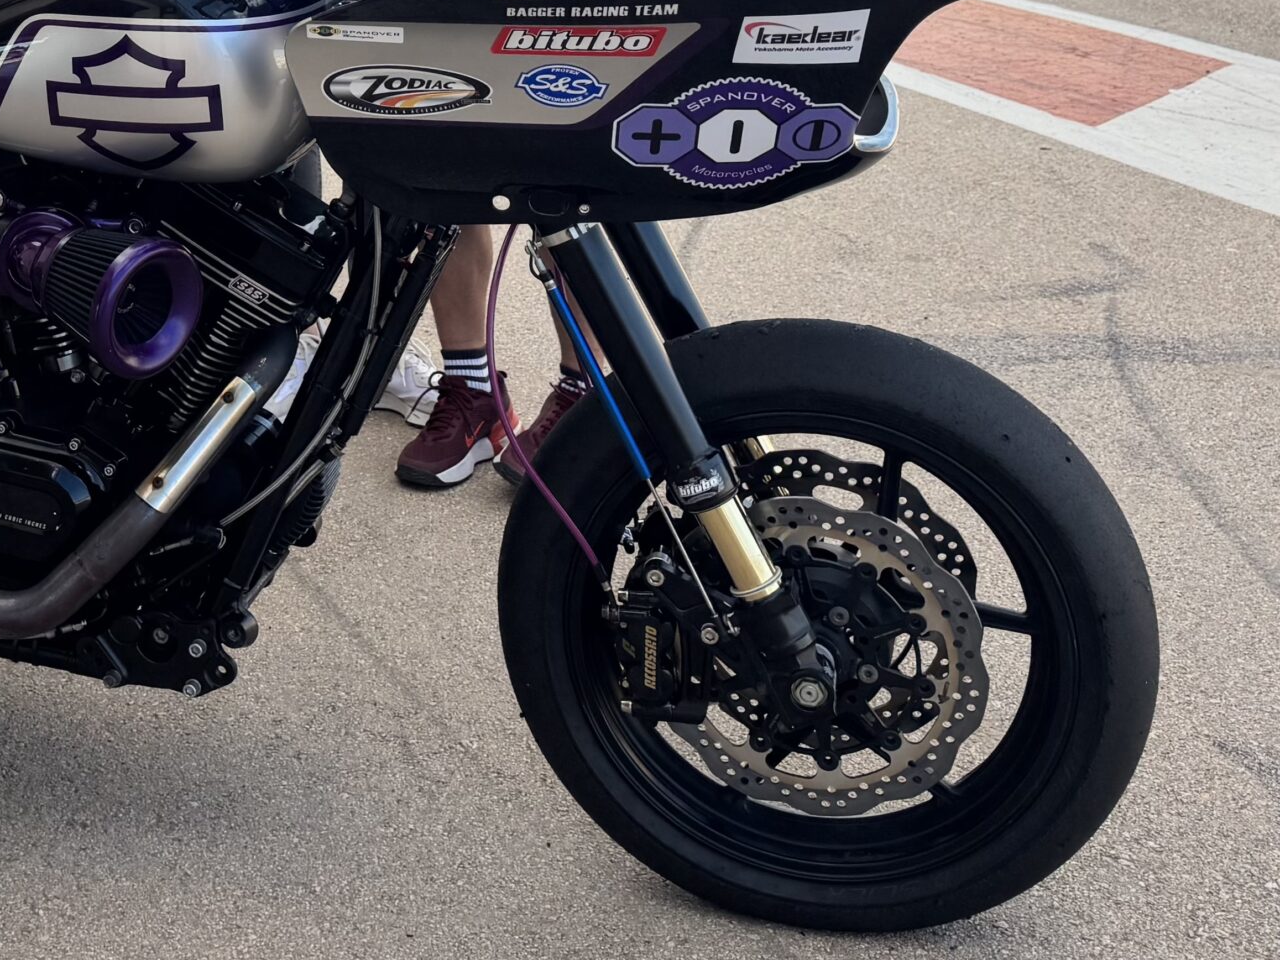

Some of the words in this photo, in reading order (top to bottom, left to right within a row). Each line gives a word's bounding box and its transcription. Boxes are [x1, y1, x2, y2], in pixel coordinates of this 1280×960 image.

[506, 7, 566, 17] BAGGER
[570, 6, 629, 17] RACING
[635, 3, 679, 16] TEAM
[341, 29, 400, 37] SPANOVER
[504, 28, 654, 52] bitubo
[550, 67, 580, 76] PROVEN
[529, 74, 593, 95] S&S
[535, 91, 584, 103] PERFORMANCE
[686, 91, 797, 114] SPANOVER
[410, 102, 460, 114] ACCESSORIES
[691, 163, 773, 179] Motorcycles
[677, 475, 720, 497] bitubo
[4, 513, 23, 524] CUBIC
[24, 519, 48, 530] INCHES
